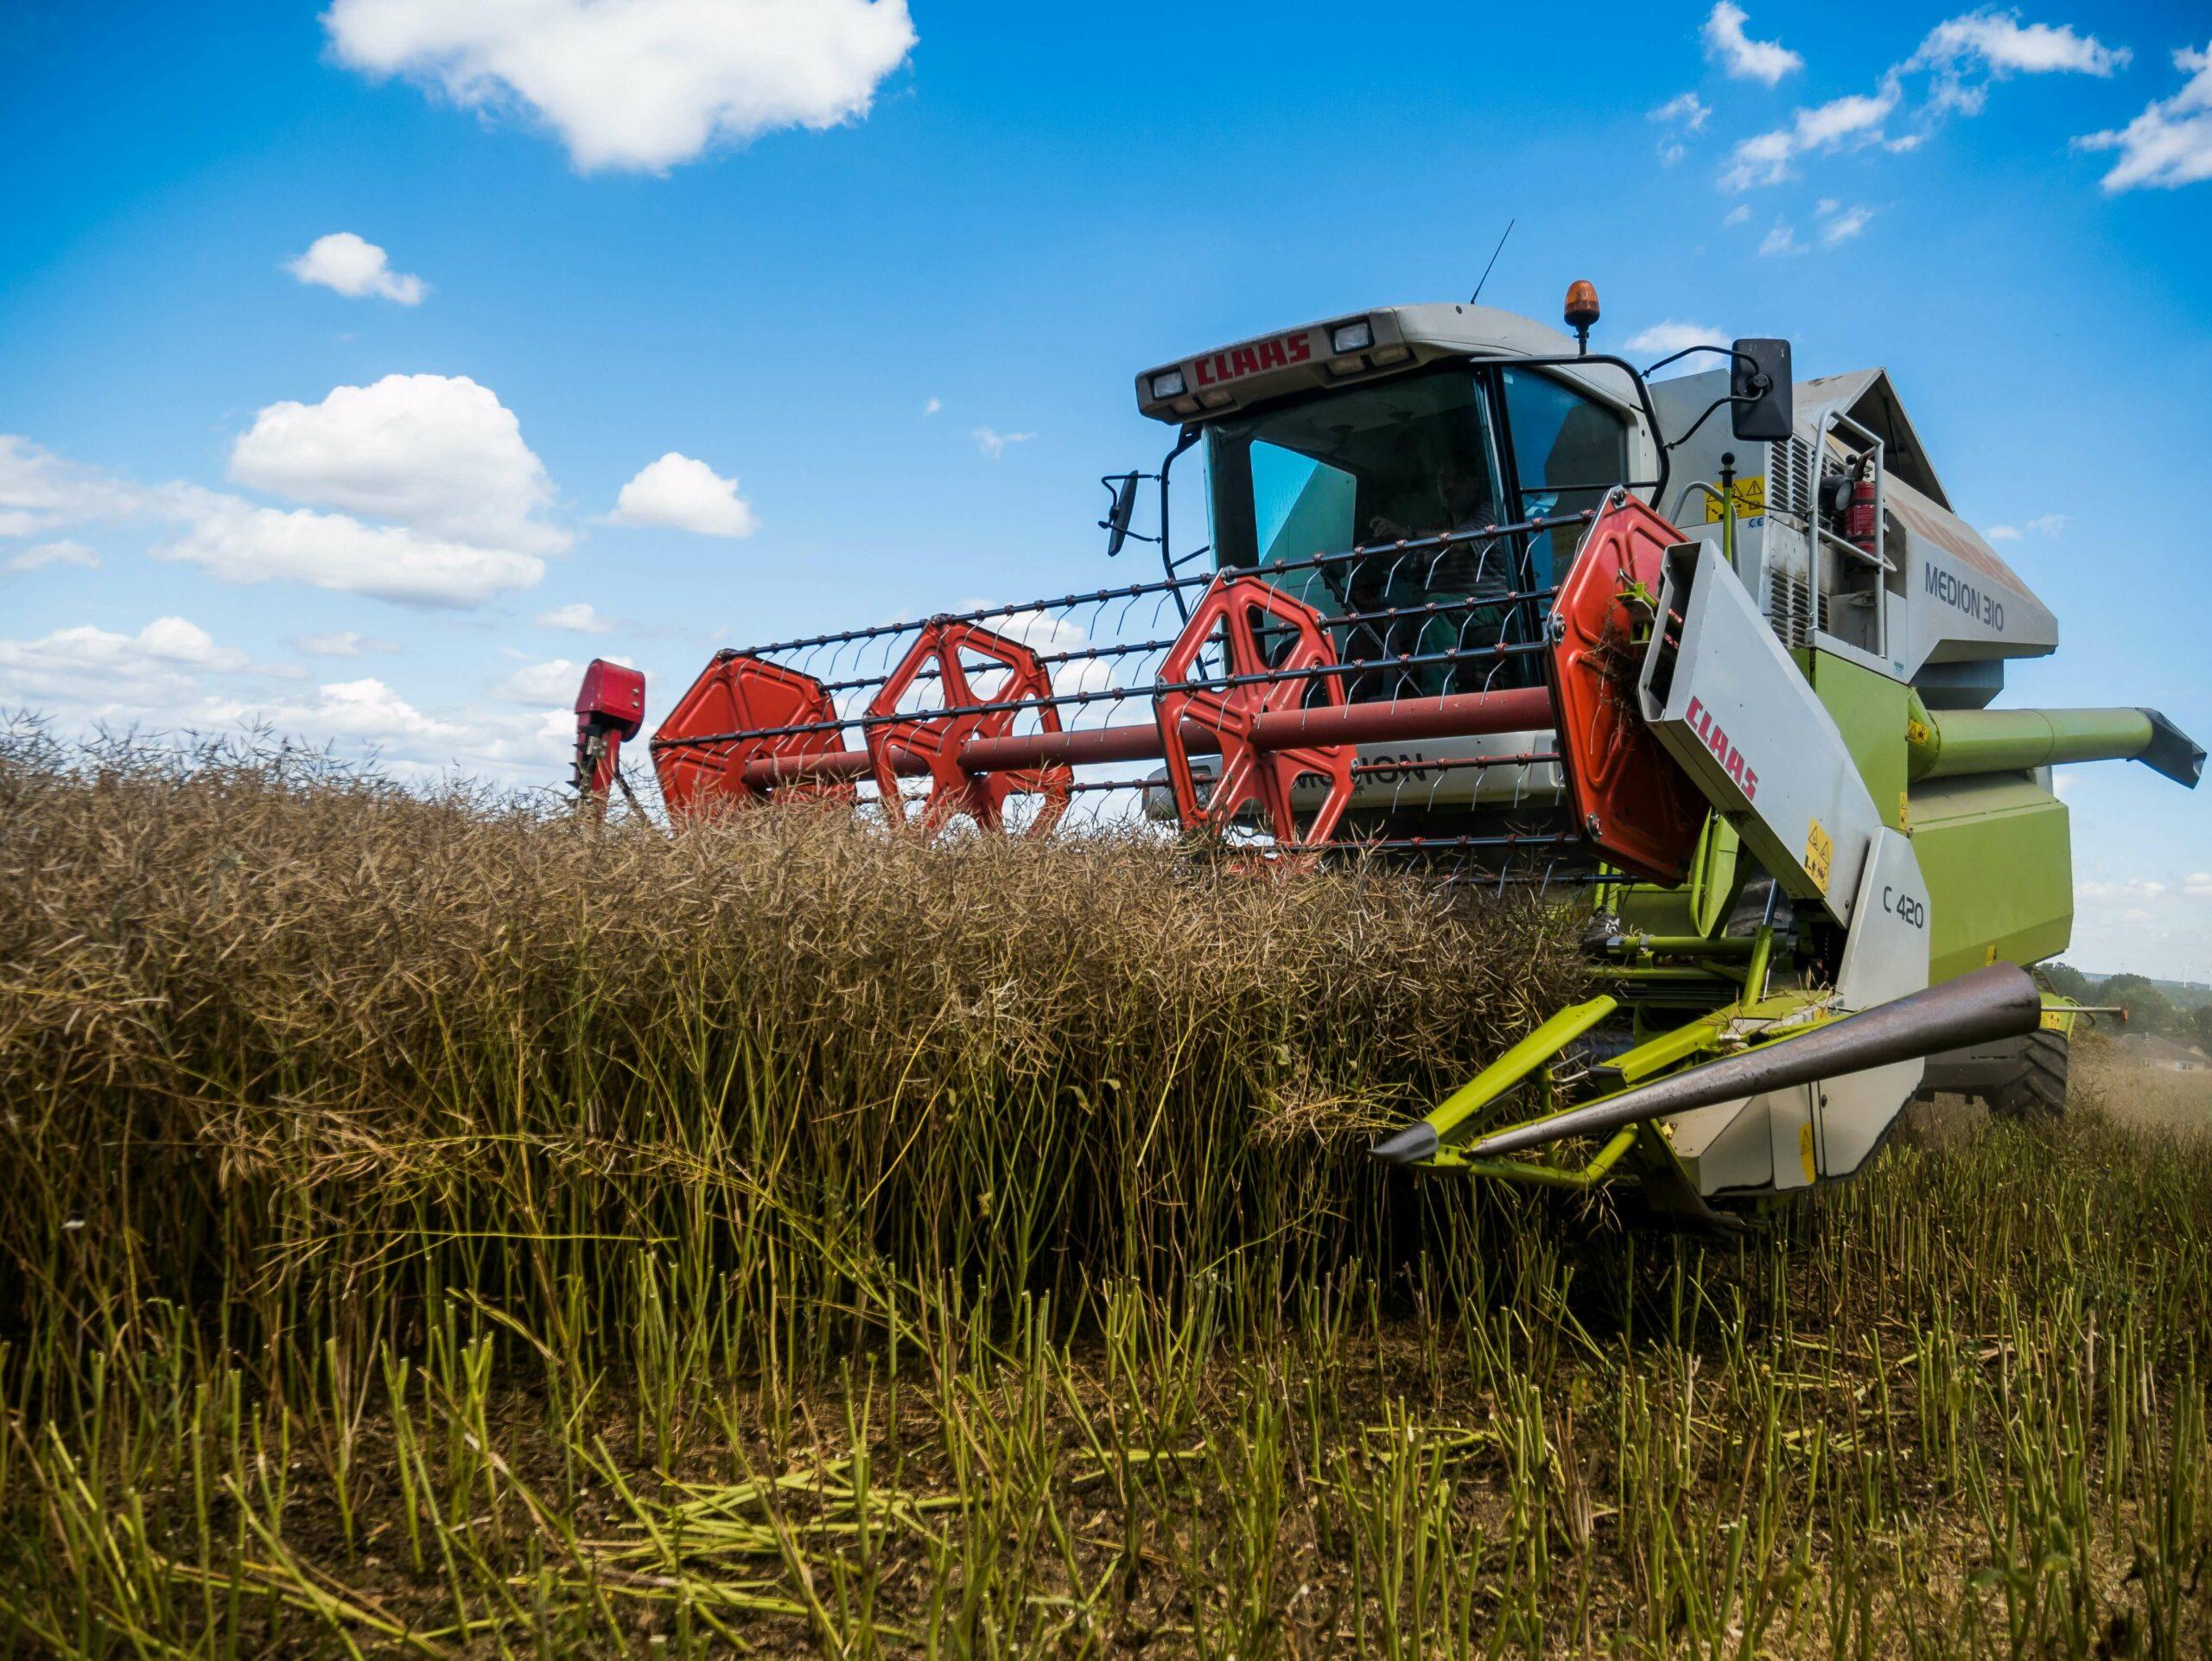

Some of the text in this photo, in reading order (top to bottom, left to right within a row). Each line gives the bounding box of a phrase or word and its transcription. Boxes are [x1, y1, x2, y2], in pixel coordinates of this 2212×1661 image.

[1194, 332, 1311, 386] CLAAS
[1925, 562, 2004, 633] MEDION 310
[1685, 695, 1758, 801] CLAAS
[1883, 885, 1924, 929] C 420
